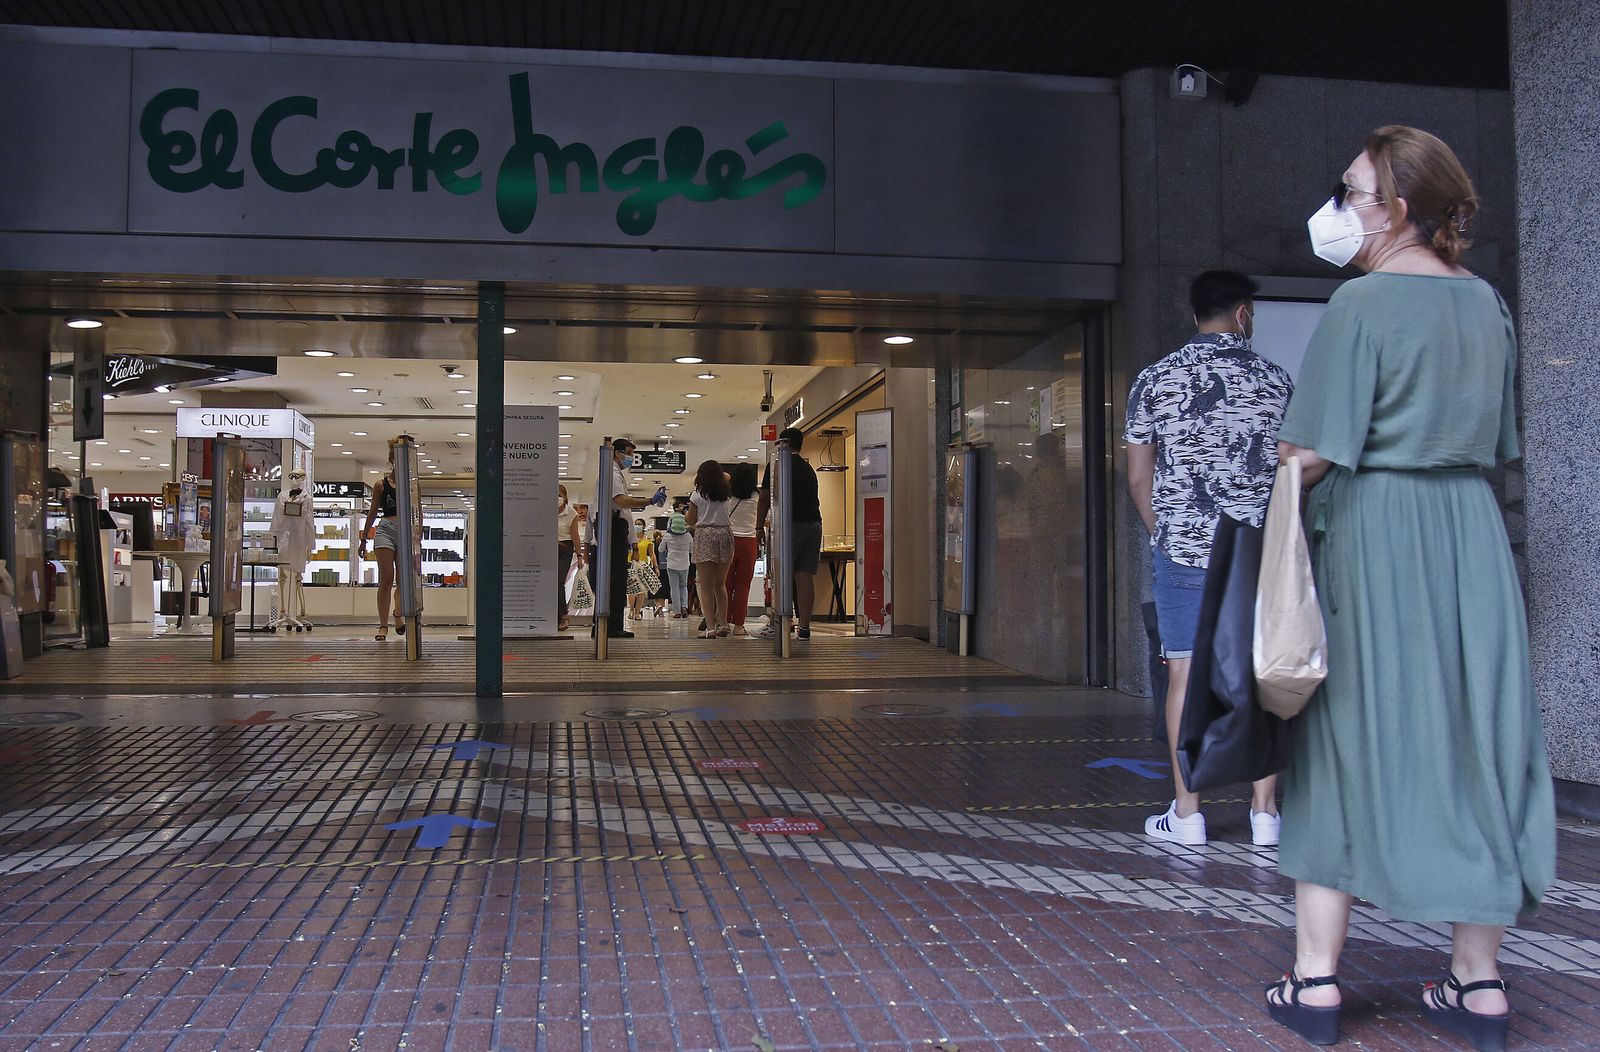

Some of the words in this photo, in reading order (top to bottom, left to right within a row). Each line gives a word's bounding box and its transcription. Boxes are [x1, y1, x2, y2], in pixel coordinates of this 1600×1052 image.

[139, 87, 244, 193] El
[251, 95, 482, 196] Corte
[495, 72, 828, 236] Inglés
[105, 357, 144, 382] Kiehl's
[200, 413, 270, 428] CLINIQUE
